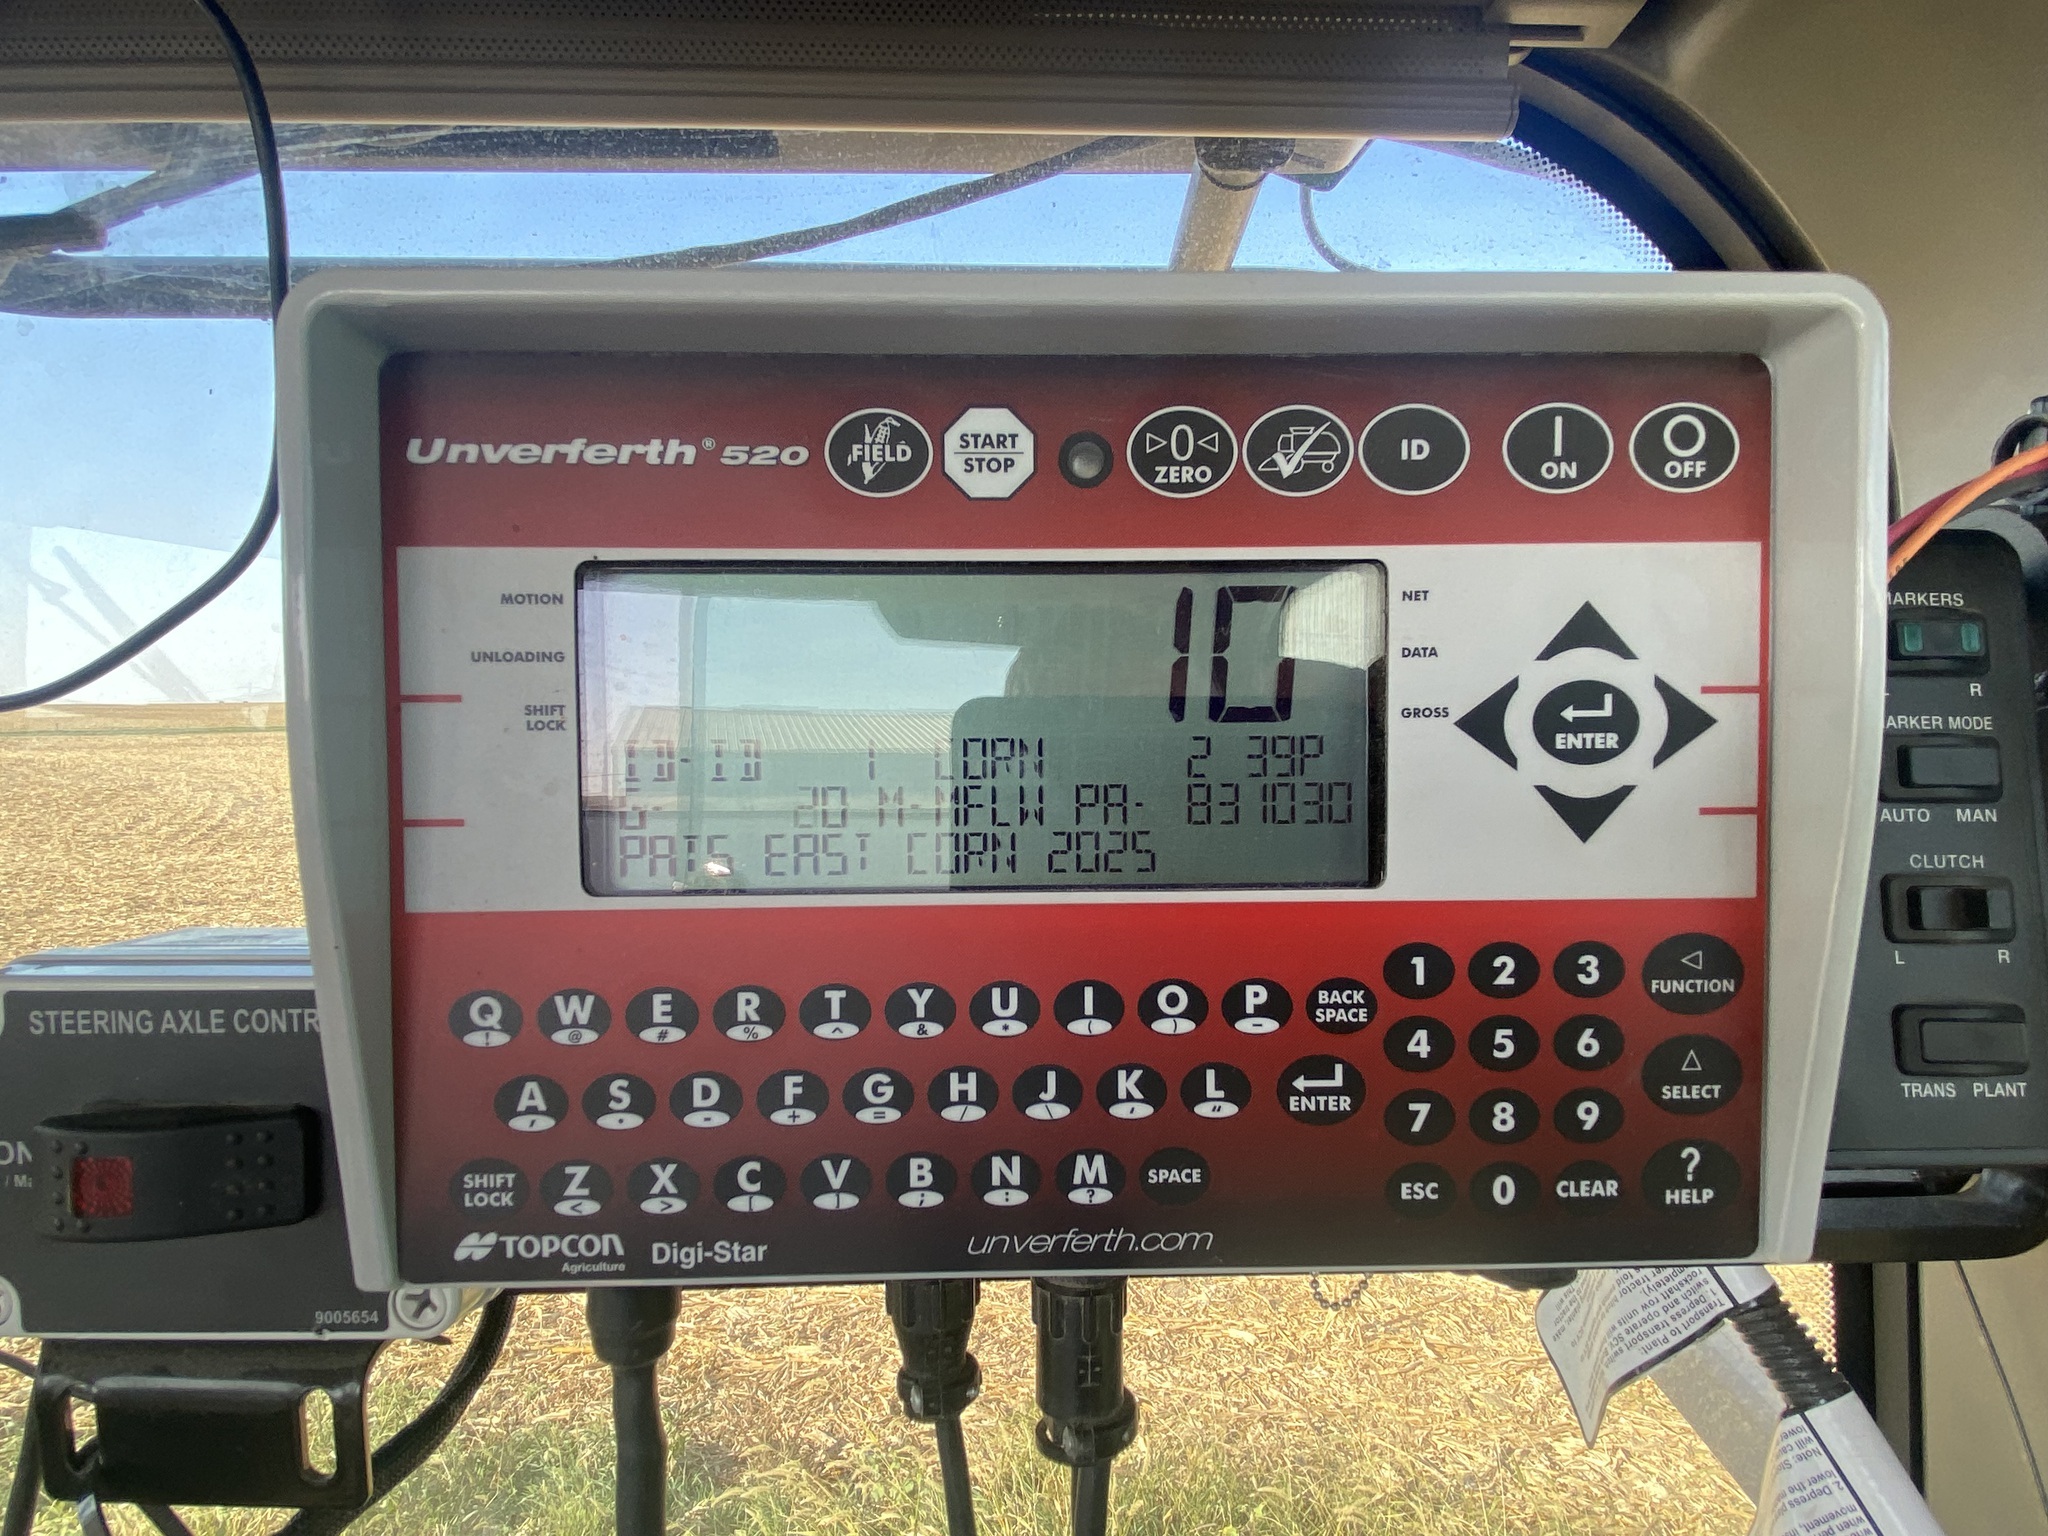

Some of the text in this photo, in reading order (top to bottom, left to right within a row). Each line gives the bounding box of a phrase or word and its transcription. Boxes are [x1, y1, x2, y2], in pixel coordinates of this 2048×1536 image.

[852, 443, 912, 463] FIELD
[960, 434, 1018, 449] START
[1402, 439, 1429, 460] ID
[720, 446, 809, 465] 520
[964, 458, 1014, 473] STOP
[1155, 466, 1211, 483] ZERO
[1541, 462, 1576, 479] ON
[1665, 461, 1706, 478] OFF
[501, 594, 563, 604] MOTION
[1403, 591, 1429, 601] NET
[471, 652, 565, 662] UNLOADING
[1168, 585, 1296, 723] 10
[1402, 647, 1438, 657] DATA
[1970, 684, 1981, 696] R
[525, 705, 565, 716] SHIFT
[1401, 707, 1449, 718] GROSS
[1949, 716, 1992, 730] MODE
[527, 720, 565, 731] LOCK
[1556, 733, 1618, 749] ENTER
[793, 786, 848, 829] 20
[1880, 808, 1997, 822] AUTO MAN
[765, 834, 871, 877] EAST
[906, 831, 1018, 876] CORN
[1047, 831, 1157, 874] 2025
[1910, 854, 1984, 868] CLUTCH
[1895, 951, 1904, 964] L
[1998, 950, 2010, 963] R
[1411, 957, 1424, 985] 1
[1493, 956, 1515, 984] 2
[1578, 955, 1599, 984] 3
[1246, 985, 1267, 1013] P
[1319, 990, 1364, 1004] BACK
[1652, 980, 1734, 993] FUNCTION
[554, 995, 594, 1024] W
[653, 994, 672, 1023] E
[737, 992, 760, 1021] R
[825, 990, 846, 1019] T
[907, 989, 933, 1017] Y
[992, 988, 1017, 1017] U
[1085, 987, 1093, 1015] I
[1158, 985, 1188, 1015] O
[30, 1010, 153, 1034] STEERING
[161, 1010, 225, 1033] AXLE
[470, 997, 501, 1029] Q
[1316, 1008, 1367, 1022] SPACE
[1407, 1030, 1430, 1058] 4
[1493, 1029, 1514, 1058] 5
[1577, 1029, 1599, 1057] 6
[609, 1079, 630, 1110] S
[693, 1078, 720, 1107] D
[785, 1076, 803, 1105] F
[863, 1074, 893, 1104] G
[950, 1072, 976, 1101] H
[1039, 1071, 1056, 1101] J
[1118, 1070, 1144, 1099] K
[1206, 1069, 1224, 1098] L
[1662, 1085, 1721, 1099] SELECT
[1901, 1083, 2026, 1097] TRANS PLANT
[517, 1082, 546, 1111] A
[1290, 1096, 1351, 1111] ENTER
[1409, 1103, 1431, 1131] 7
[1493, 1102, 1515, 1131] 8
[1577, 1101, 1599, 1130] 9
[822, 1160, 851, 1189] V
[910, 1158, 933, 1187] B
[992, 1156, 1020, 1185] N
[1073, 1155, 1107, 1184] M
[1149, 1169, 1201, 1183] SPACE
[1681, 1147, 1700, 1181] ?
[464, 1174, 515, 1188] SHIFT
[563, 1166, 590, 1196] Z
[650, 1164, 677, 1194] X
[738, 1162, 760, 1192] C
[1557, 1180, 1618, 1197] CLEAR
[465, 1192, 513, 1207] LOCK
[1401, 1183, 1438, 1199] ESC
[1493, 1175, 1515, 1205] 0
[1666, 1189, 1713, 1204] HELP
[499, 1233, 624, 1257] TOPCON
[967, 1228, 1214, 1255] unverferth.com
[652, 1241, 767, 1269] Digi-Star
[562, 1262, 625, 1274] Agriculture
[1614, 1271, 1635, 1289] fold
[1617, 1274, 1651, 1299] tractor
[1660, 1268, 1703, 1301] rockshaft
[1680, 1277, 1710, 1302] switch
[1640, 1296, 1660, 1313] row
[1661, 1297, 1681, 1315] and
[1669, 1293, 1707, 1323] Depress
[1680, 1297, 1725, 1331] Transport
[315, 1311, 378, 1324] 9005654
[1616, 1308, 1640, 1328] units
[1623, 1308, 1661, 1338] operate
[1623, 1317, 1670, 1352] transport
[1670, 1326, 1682, 1338] to
[1794, 1435, 1814, 1449] will
[1792, 1447, 1822, 1464] Note:
[1787, 1469, 1837, 1494] lower the
[1787, 1484, 1833, 1509] Depress
[1799, 1503, 1858, 1534] movement,
